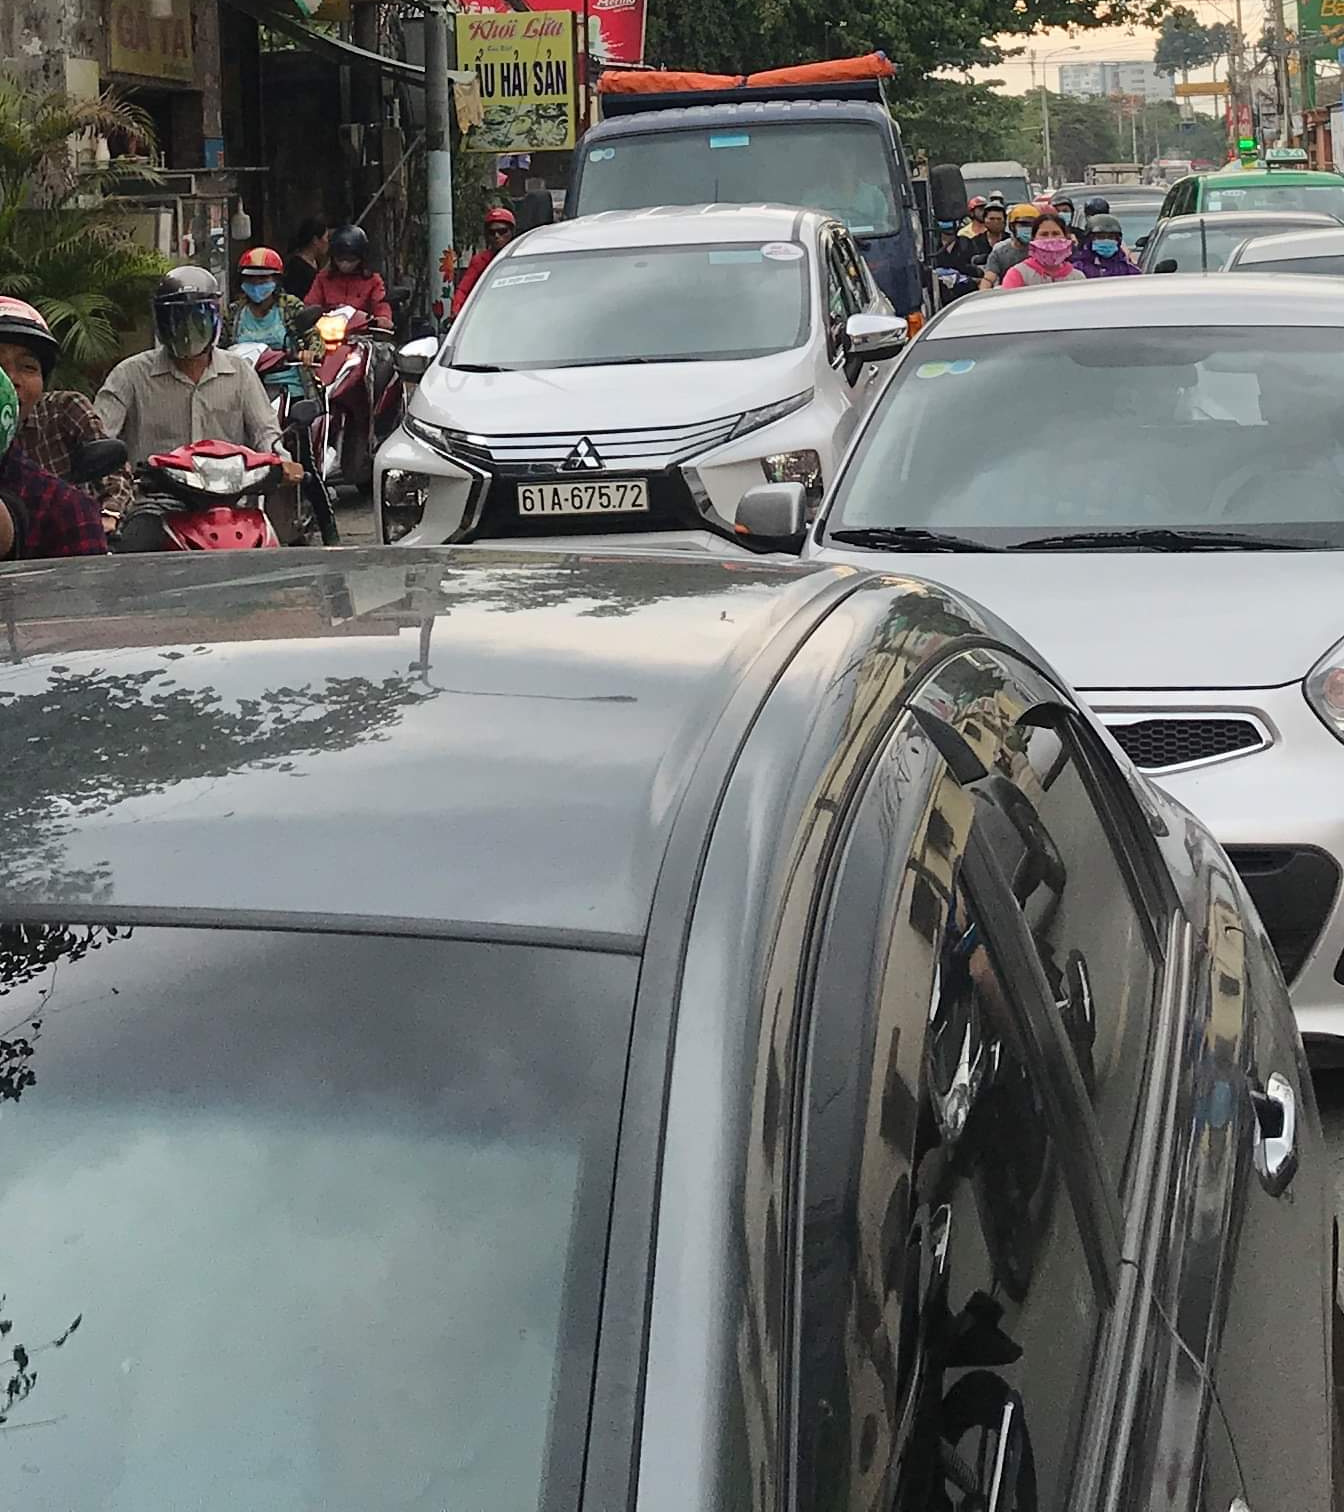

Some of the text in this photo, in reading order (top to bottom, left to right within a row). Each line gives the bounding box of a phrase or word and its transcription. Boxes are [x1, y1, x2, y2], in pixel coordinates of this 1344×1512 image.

[464, 48, 568, 98] ẨU HẢI SẢN
[521, 483, 644, 513] 61A-675.72
